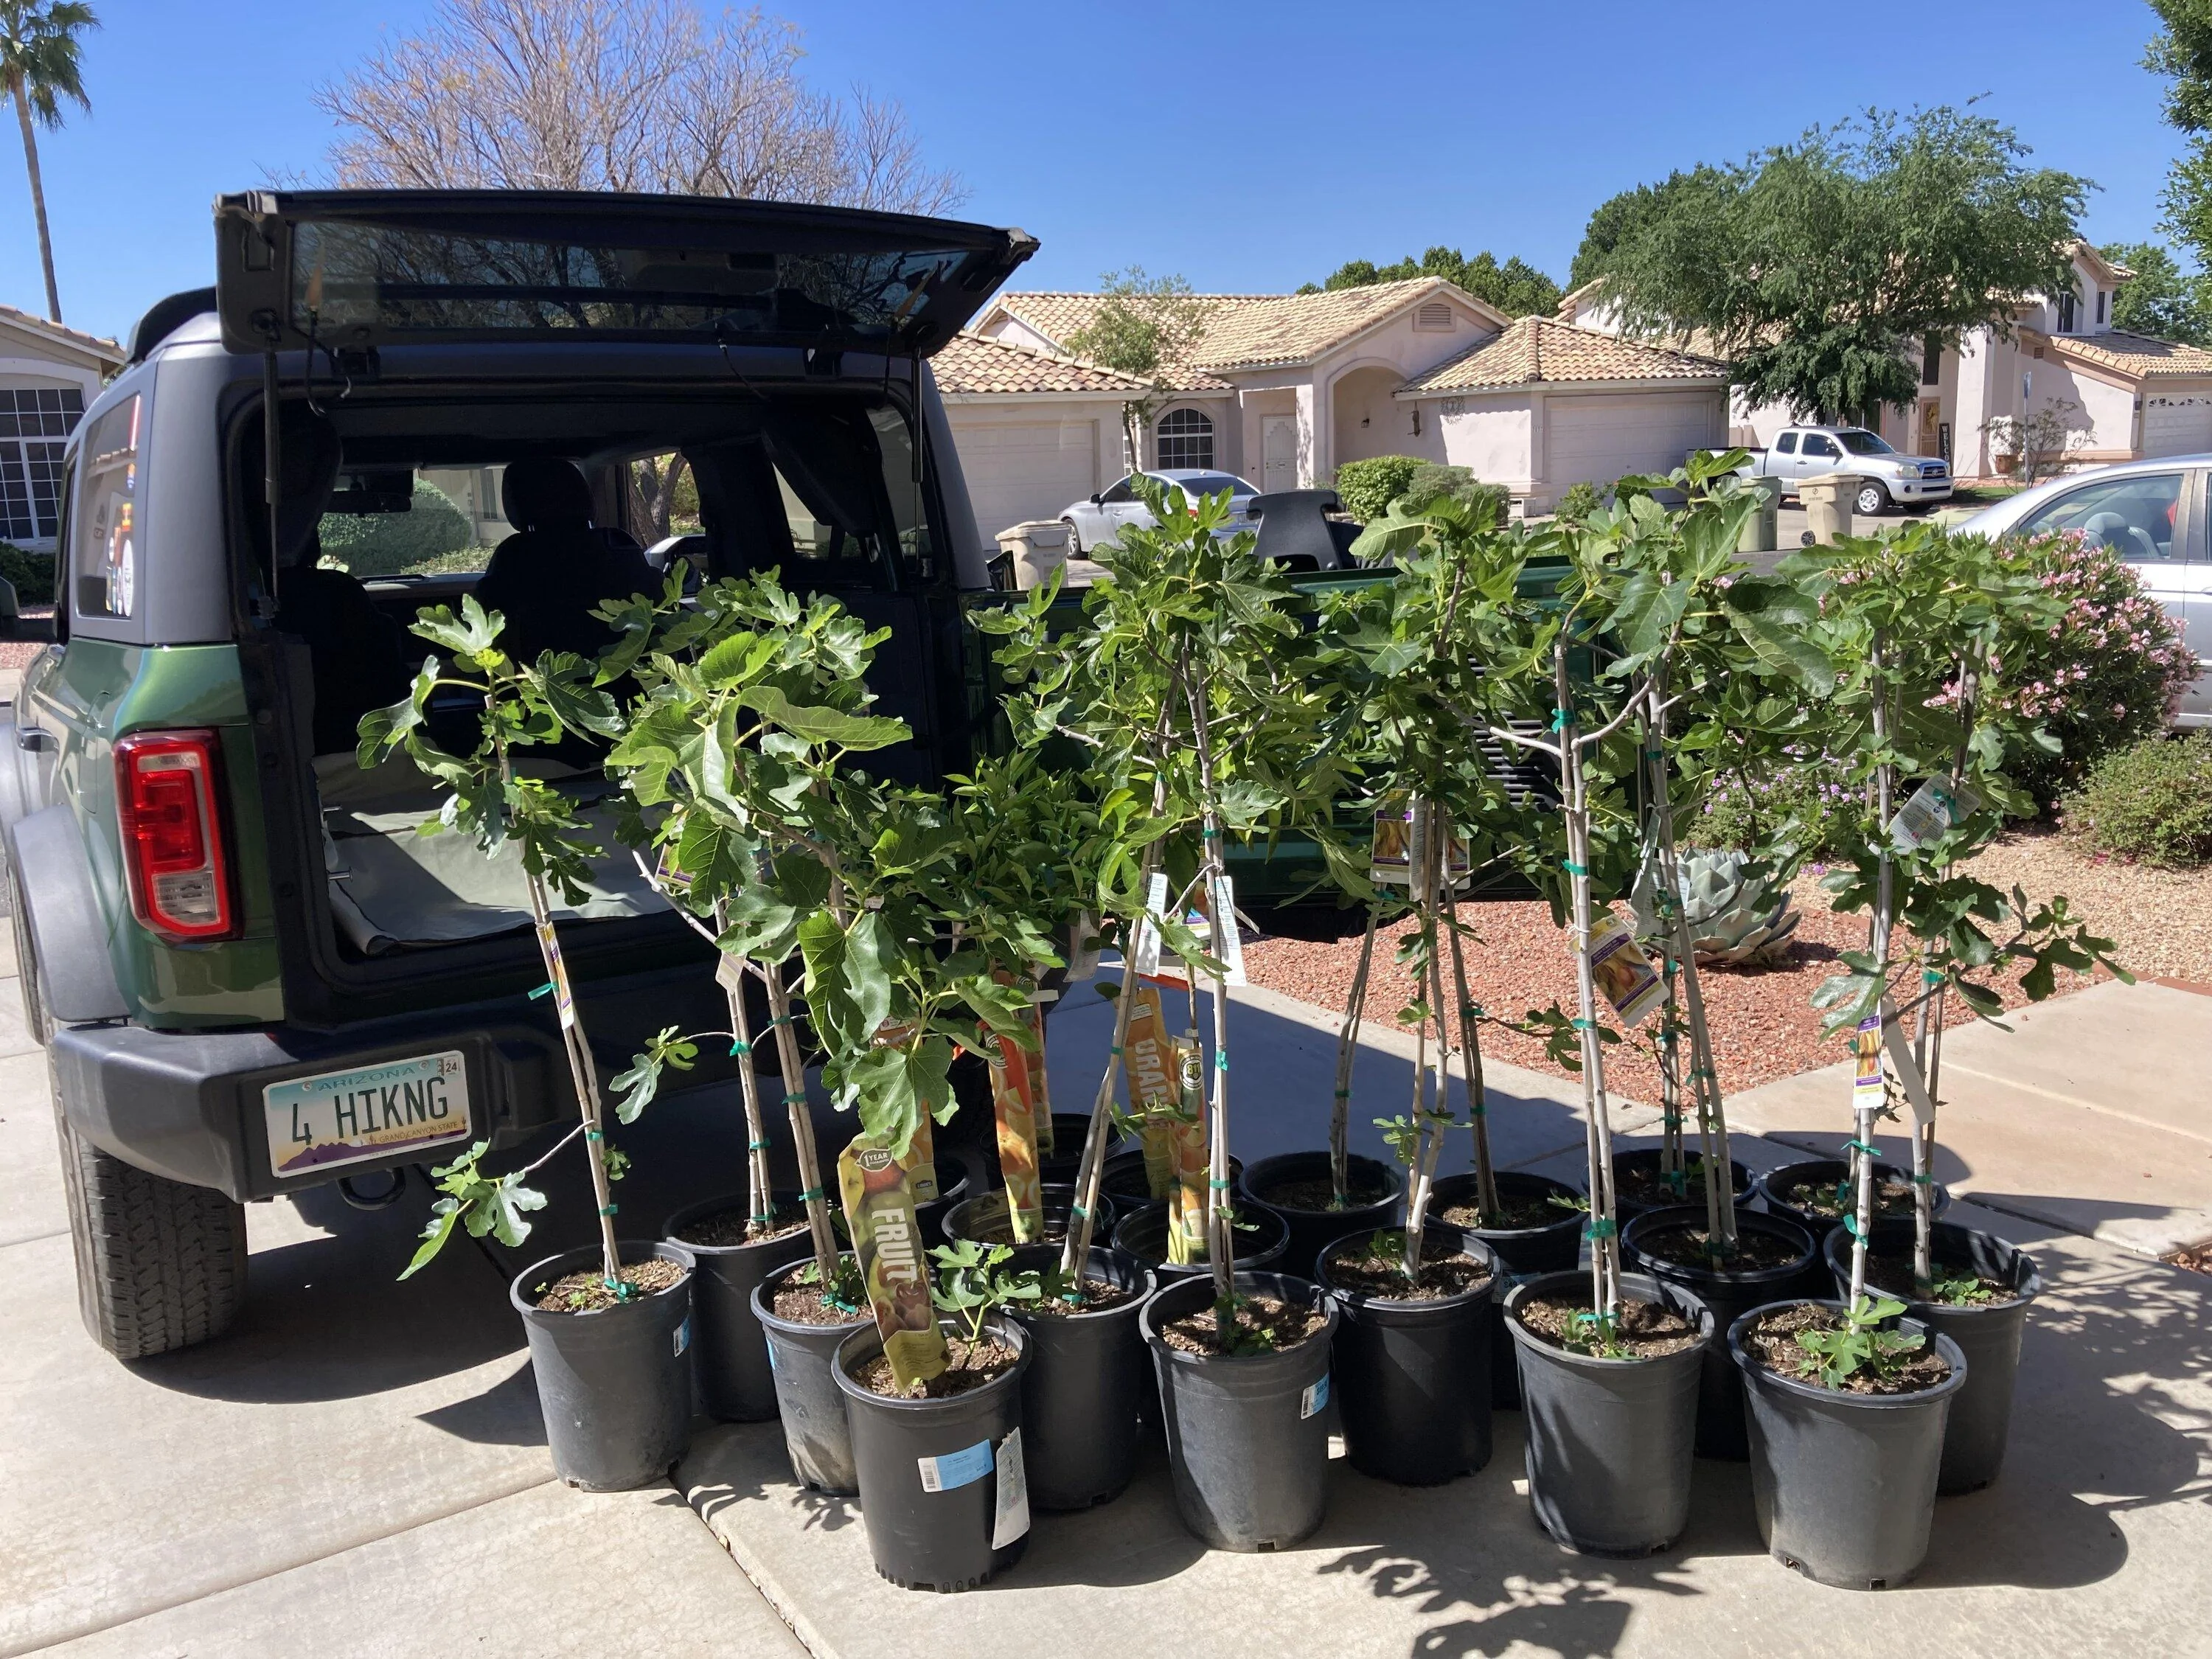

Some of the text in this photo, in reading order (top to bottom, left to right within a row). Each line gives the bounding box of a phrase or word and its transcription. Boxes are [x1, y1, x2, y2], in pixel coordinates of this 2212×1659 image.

[1941, 425, 1950, 461] WELCO
[318, 1067, 415, 1091] ARIZONA
[445, 1062, 458, 1073] 24
[1186, 1062, 1200, 1075] 811
[292, 1077, 448, 1145] 4 HIKNG
[379, 1132, 406, 1144] GRAND
[406, 1126, 437, 1138] CANYON
[438, 1121, 459, 1131] STATE
[864, 1152, 888, 1167] 1 YEAR
[871, 1208, 918, 1281] FRUIT
